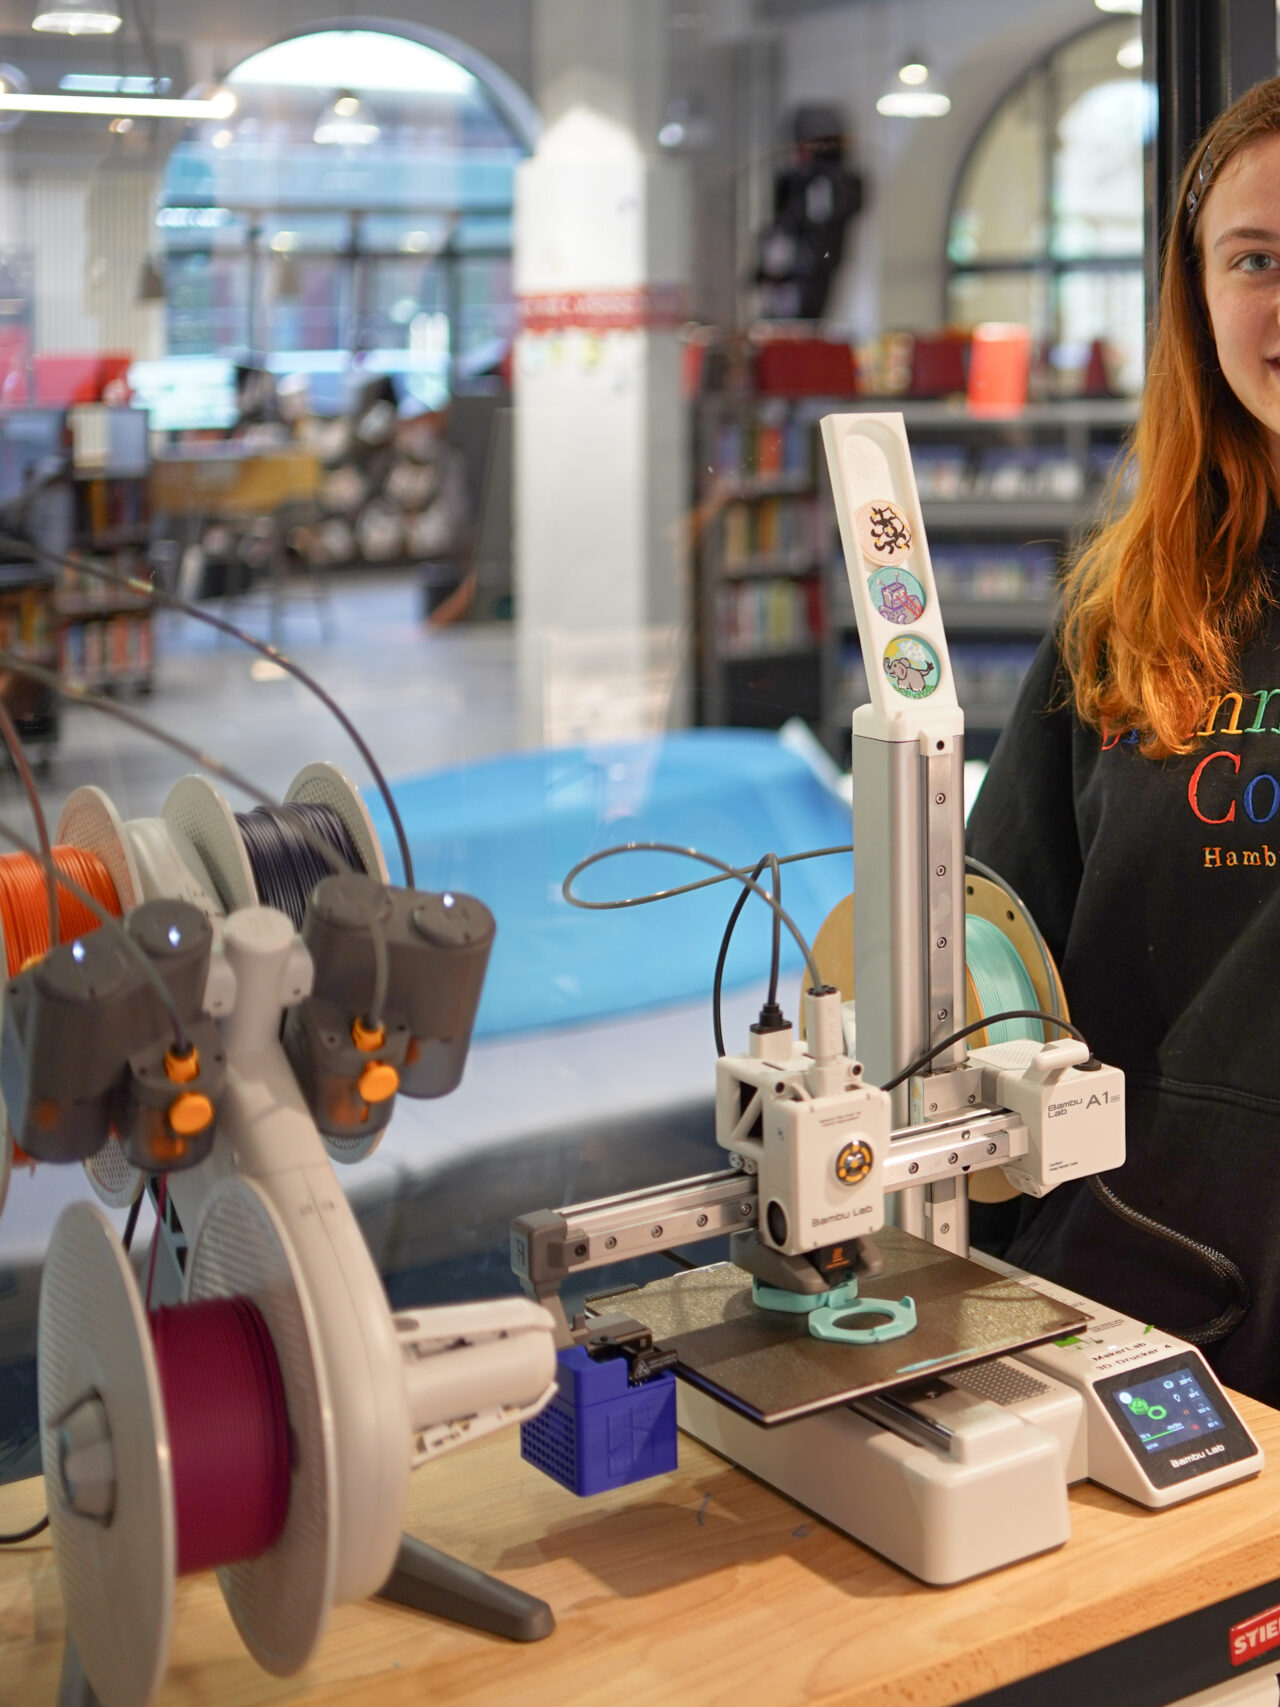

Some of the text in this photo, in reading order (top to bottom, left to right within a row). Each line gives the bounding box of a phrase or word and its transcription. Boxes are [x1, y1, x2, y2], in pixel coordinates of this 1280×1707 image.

[1048, 1098, 1083, 1112] Bambu
[1086, 1091, 1109, 1110] A1
[1048, 1109, 1068, 1118] Lab
[811, 1205, 873, 1228] Bambu Lab
[1170, 1444, 1226, 1469] Bambu Lab
